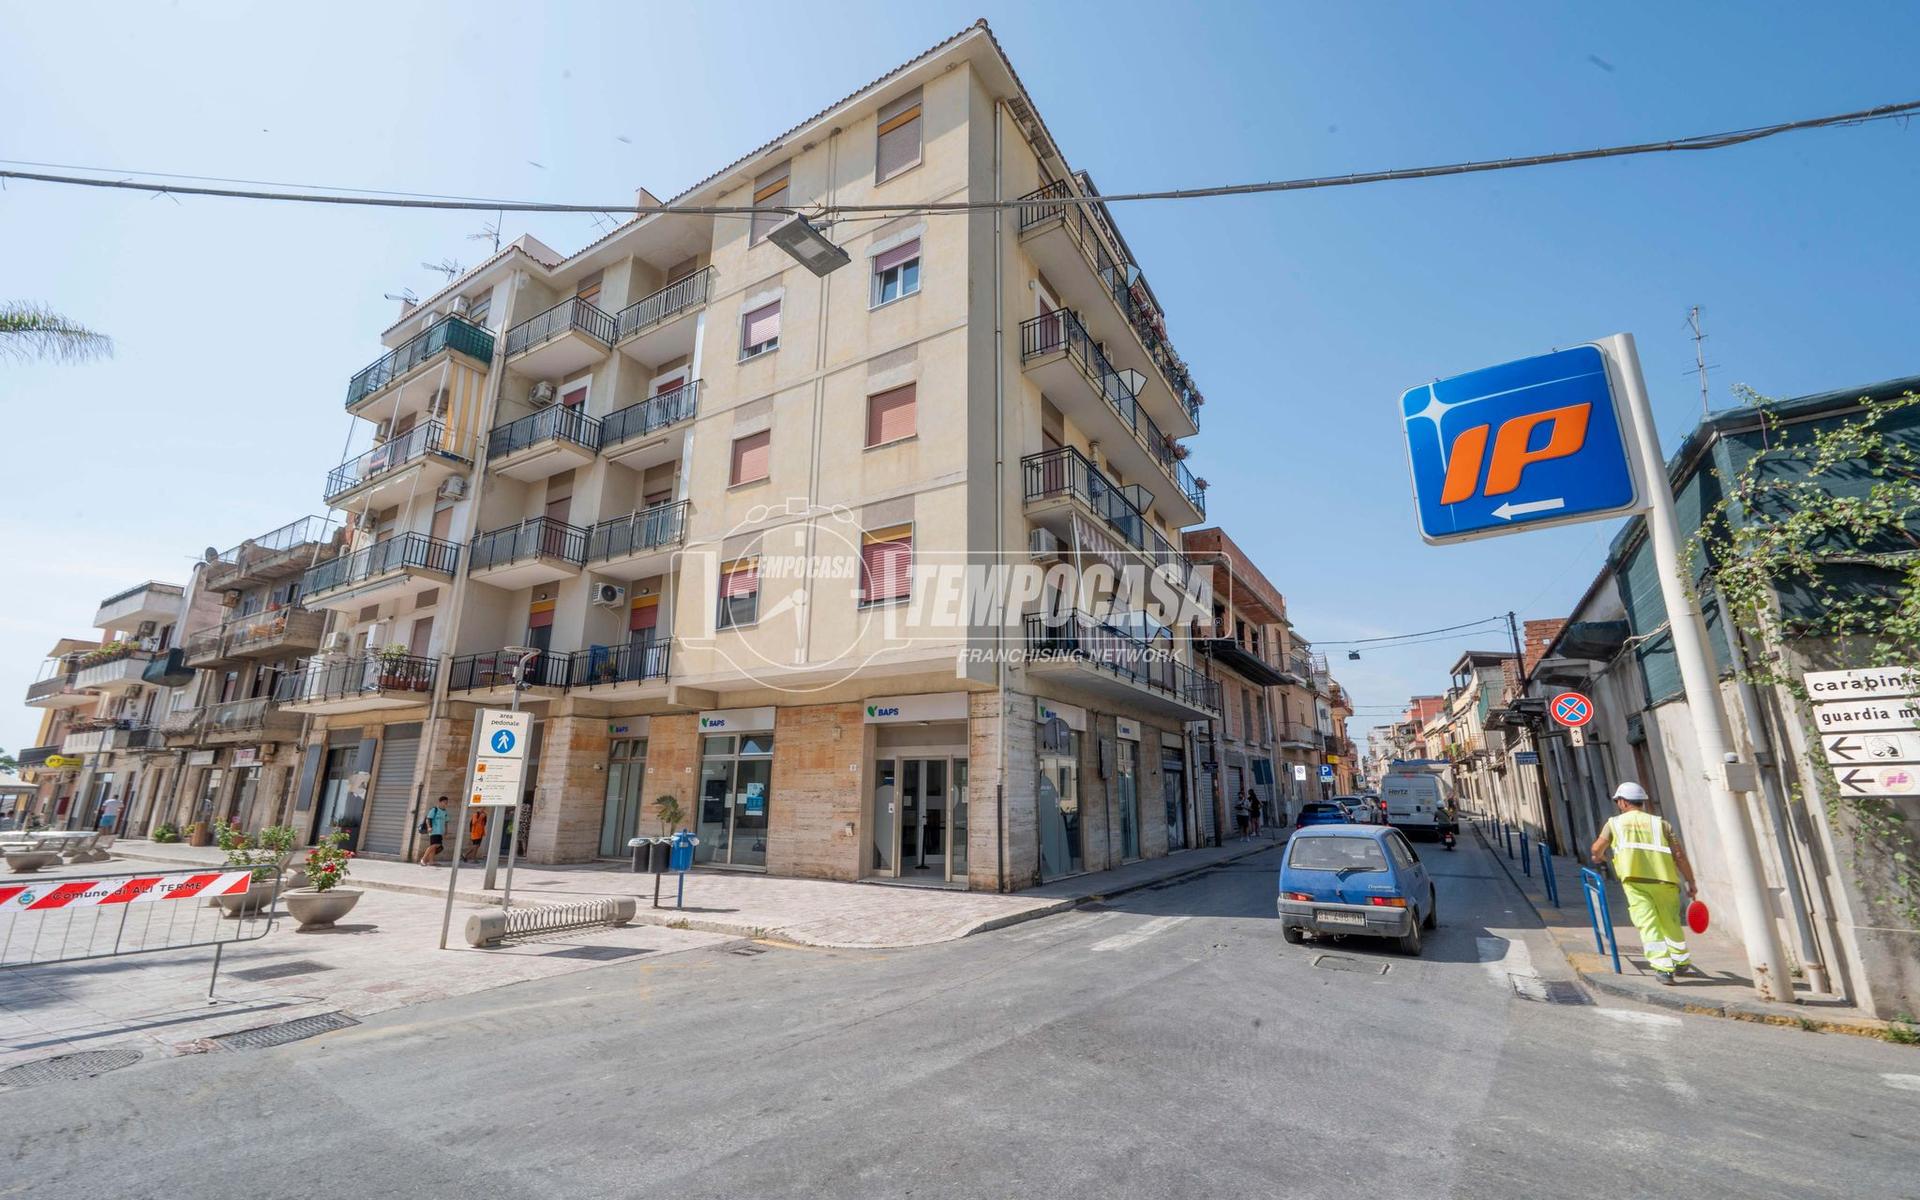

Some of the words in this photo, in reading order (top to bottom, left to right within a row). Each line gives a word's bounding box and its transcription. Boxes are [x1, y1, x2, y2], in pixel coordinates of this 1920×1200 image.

[1440, 402, 1593, 505] IP
[878, 707, 899, 716] BAPS
[1822, 707, 1890, 725] guardia
[1898, 708, 1920, 719] m
[491, 719, 520, 727] pedonale
[709, 719, 725, 728] BAPS
[615, 725, 629, 733] BAPS
[1321, 766, 1329, 775] P
[52, 890, 107, 900] Comune
[112, 887, 127, 895] di
[160, 882, 202, 892] TERME
